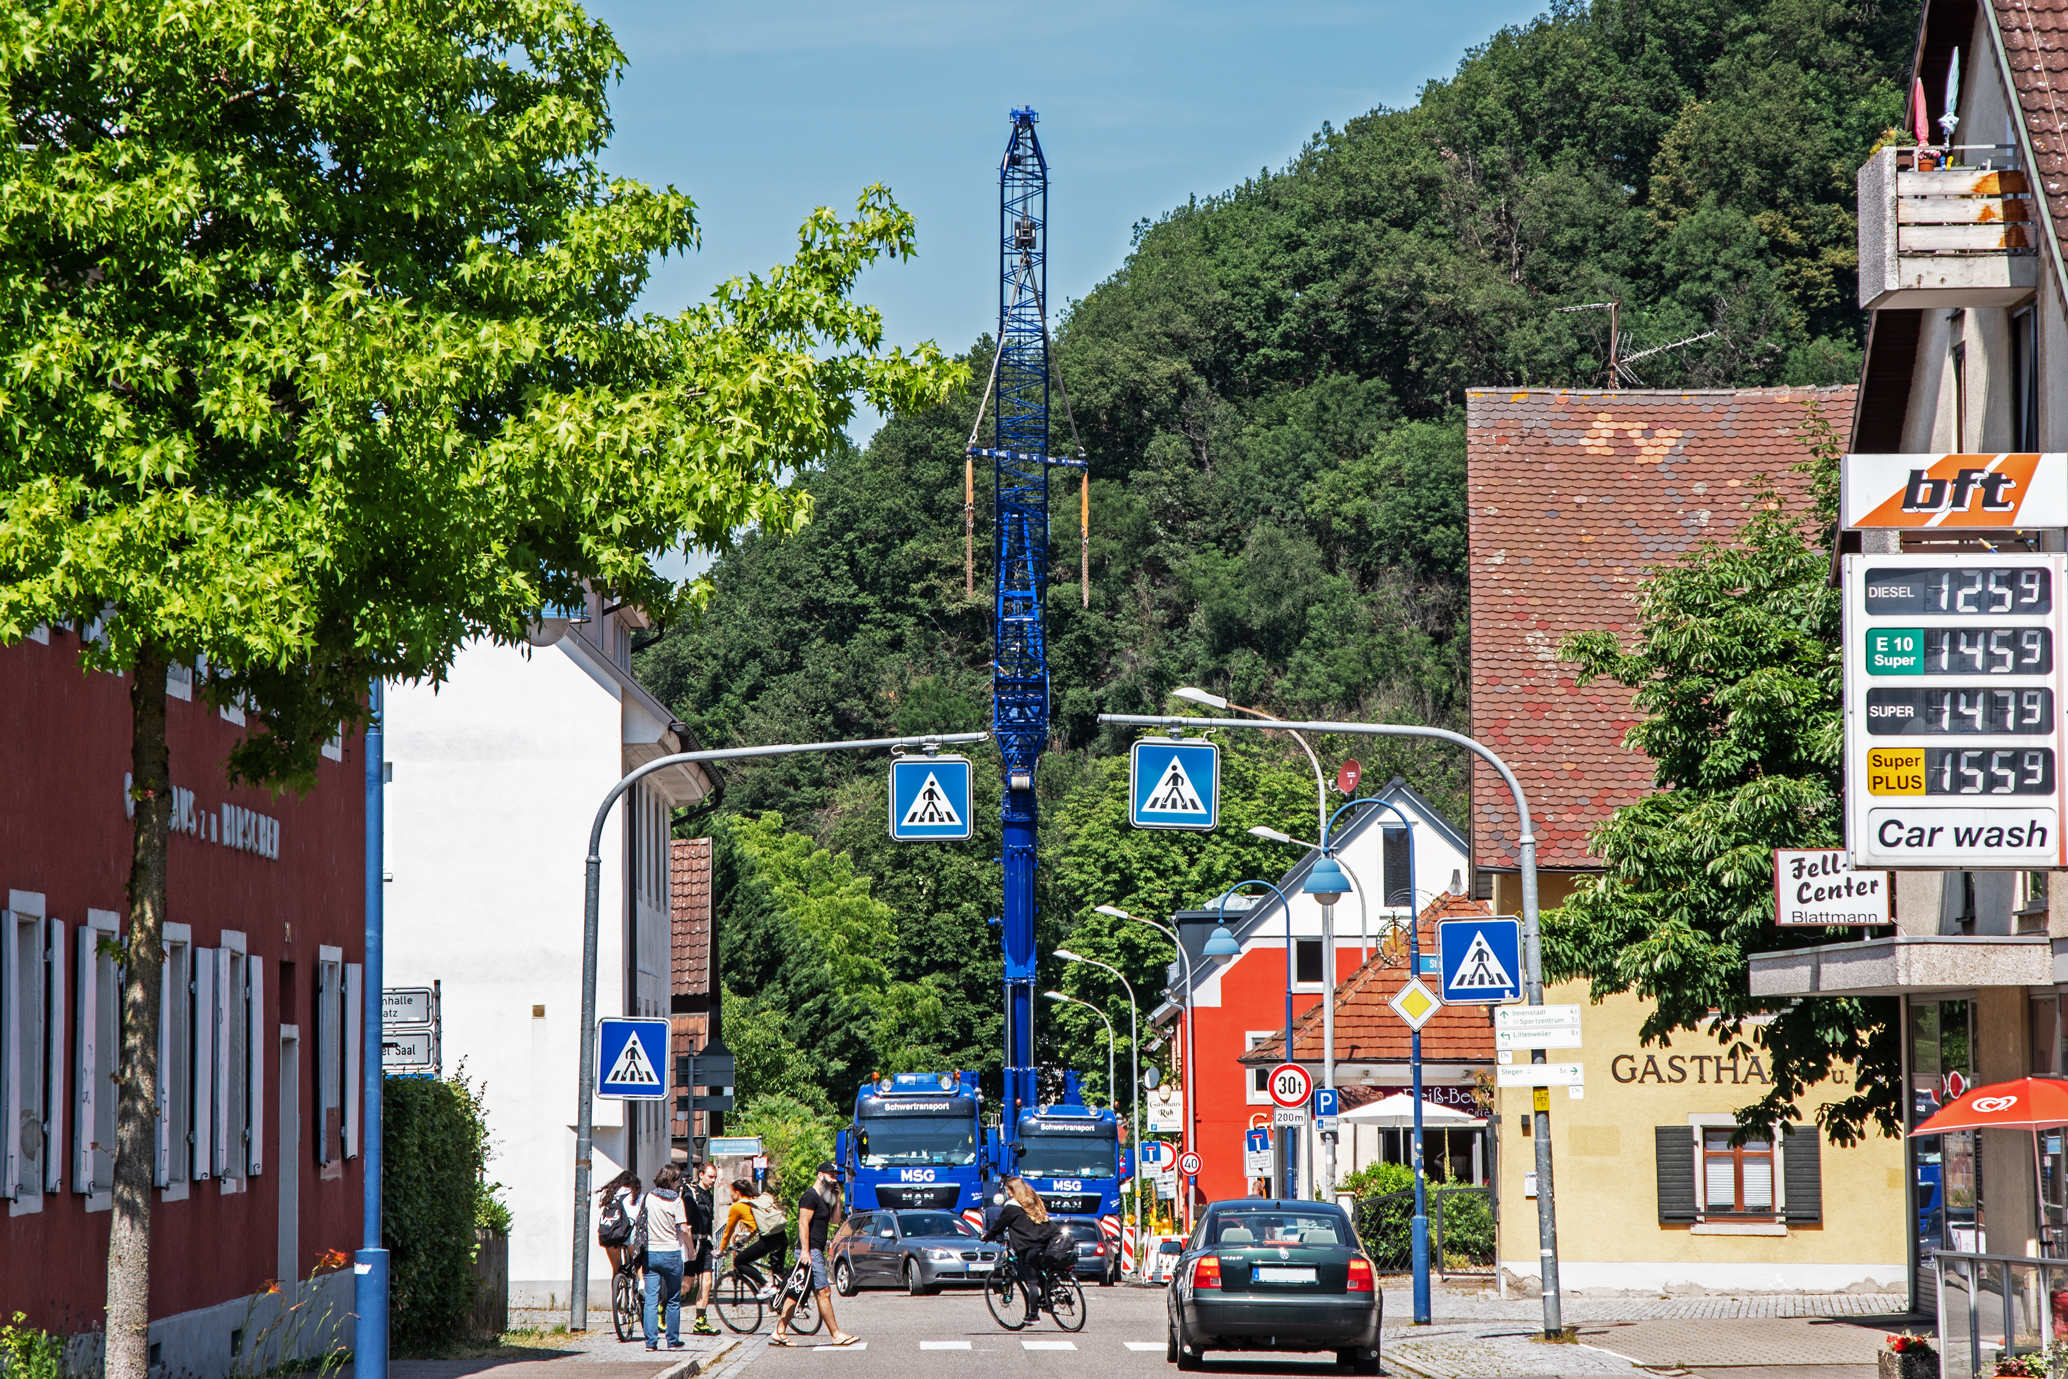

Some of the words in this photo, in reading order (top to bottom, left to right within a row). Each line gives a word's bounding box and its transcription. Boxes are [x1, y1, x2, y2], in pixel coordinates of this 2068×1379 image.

[1901, 469, 2017, 513] bft
[1868, 586, 1915, 598] DIESEL
[1876, 637, 1888, 651] E
[1893, 637, 1913, 651] 10
[1874, 654, 1916, 667] Super
[1869, 705, 1914, 718] SUPER
[1872, 754, 1921, 770] Super
[1872, 775, 1922, 790] PLUS
[1878, 818, 1944, 848] Car
[1953, 819, 2048, 848] wash
[1796, 876, 1880, 904] Center
[1791, 910, 1878, 923] Blattmann
[383, 1010, 398, 1018] atz
[1512, 1009, 1546, 1017] Innenstadt
[1519, 1018, 1565, 1026] Sportzentrum
[1513, 1030, 1551, 1038] Littenweiler
[1501, 1068, 1524, 1077] Stegen
[884, 1102, 950, 1112] Schwertransport
[1040, 1123, 1095, 1133] Schwertransport
[1184, 1158, 1198, 1169] 40
[900, 1169, 936, 1182] MSG
[1053, 1180, 1082, 1191] MSG
[902, 1193, 935, 1201] MAN
